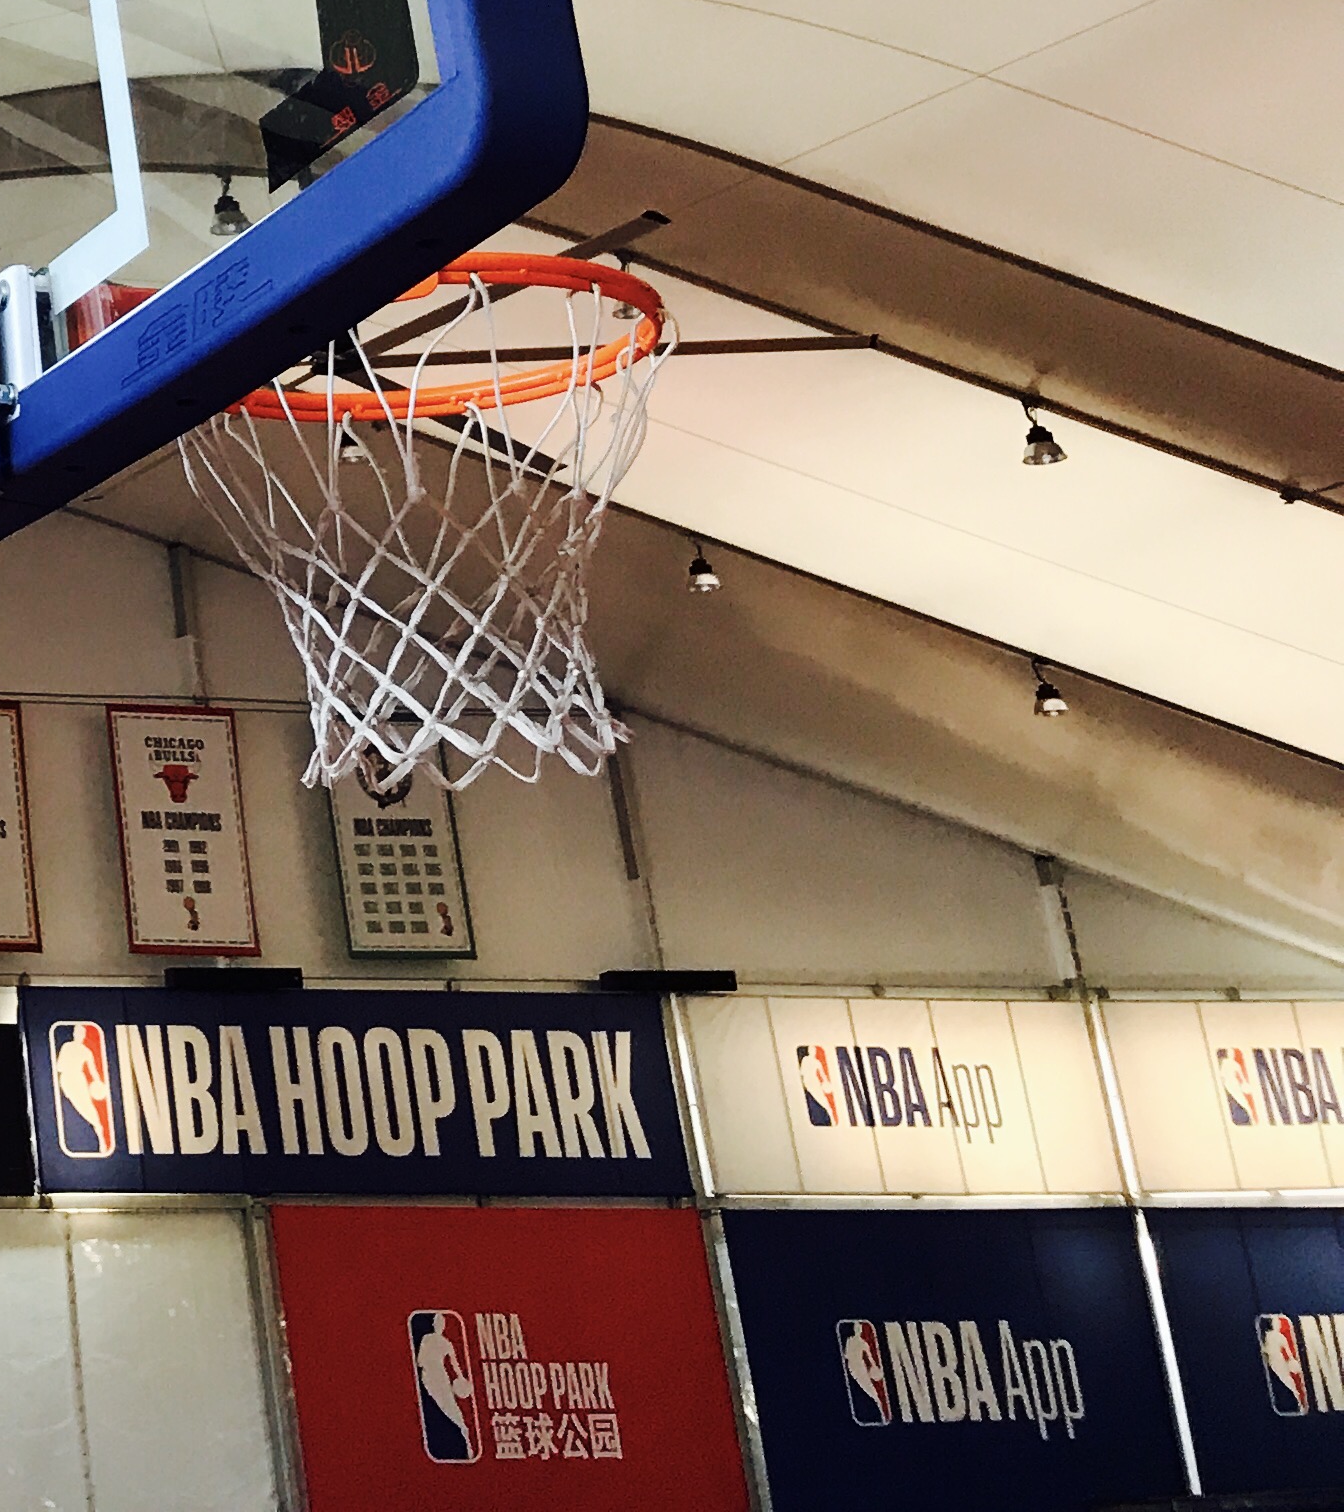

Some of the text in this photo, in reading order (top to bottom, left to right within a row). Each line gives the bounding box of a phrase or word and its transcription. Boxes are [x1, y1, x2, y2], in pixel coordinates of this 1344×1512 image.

[144, 736, 205, 751] CHICAGO
[153, 749, 196, 762] BULLS
[140, 811, 222, 831] NBA CHAMPIONS
[115, 1024, 653, 1159] NBA HOOP PARK
[835, 1045, 1003, 1145] NBA App
[1252, 1047, 1344, 1126] NBA
[475, 1312, 528, 1360] NBA
[482, 1362, 614, 1410] HOOP PARK
[884, 1320, 1086, 1441] NBA App
[491, 1412, 623, 1460] 篮球公园
